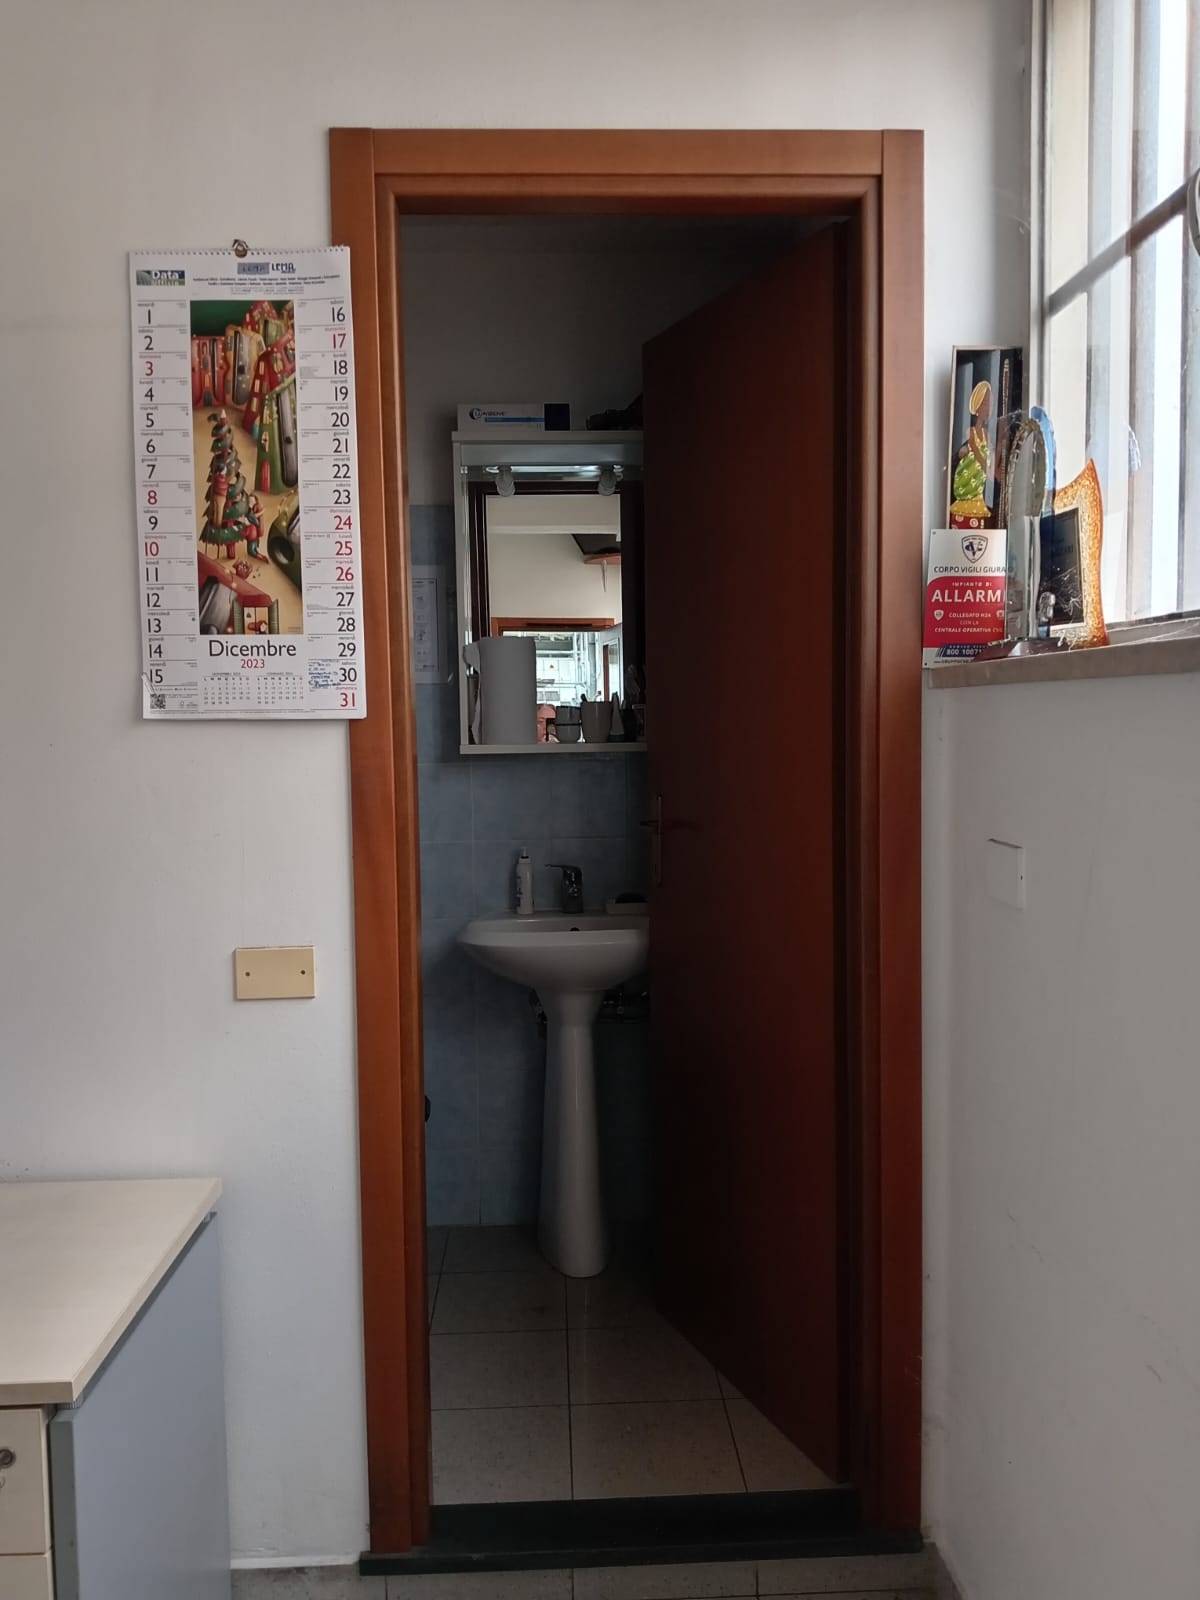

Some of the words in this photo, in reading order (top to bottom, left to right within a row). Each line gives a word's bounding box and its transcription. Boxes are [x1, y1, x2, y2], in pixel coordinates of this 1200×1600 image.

[331, 306, 346, 323] 16
[144, 335, 154, 351] 2
[333, 333, 346, 349] 17
[145, 361, 154, 376] 3
[334, 360, 348, 375] 18
[144, 386, 154, 402] 4
[335, 386, 349, 401] 19
[145, 412, 154, 428] 5
[331, 412, 350, 427] 20
[146, 439, 156, 454] 6
[332, 438, 348, 453] 21
[146, 464, 156, 479] 7
[332, 464, 351, 479] 22
[147, 490, 158, 505] 8
[332, 489, 351, 505] 23
[148, 515, 158, 531] 9
[334, 515, 352, 530] 24
[144, 541, 159, 557] 10
[335, 541, 353, 556] 25
[146, 567, 158, 582] 11
[336, 567, 354, 582] 26
[146, 592, 161, 608] 12
[336, 592, 355, 607] 27
[147, 618, 162, 633] 13
[337, 617, 356, 632] 28
[149, 644, 163, 659] 14
[209, 640, 297, 657] Dicembre
[338, 642, 356, 657] 29
[240, 659, 265, 669] 2023
[150, 669, 163, 684] 15
[339, 667, 357, 682] 30
[340, 692, 355, 708] 31
